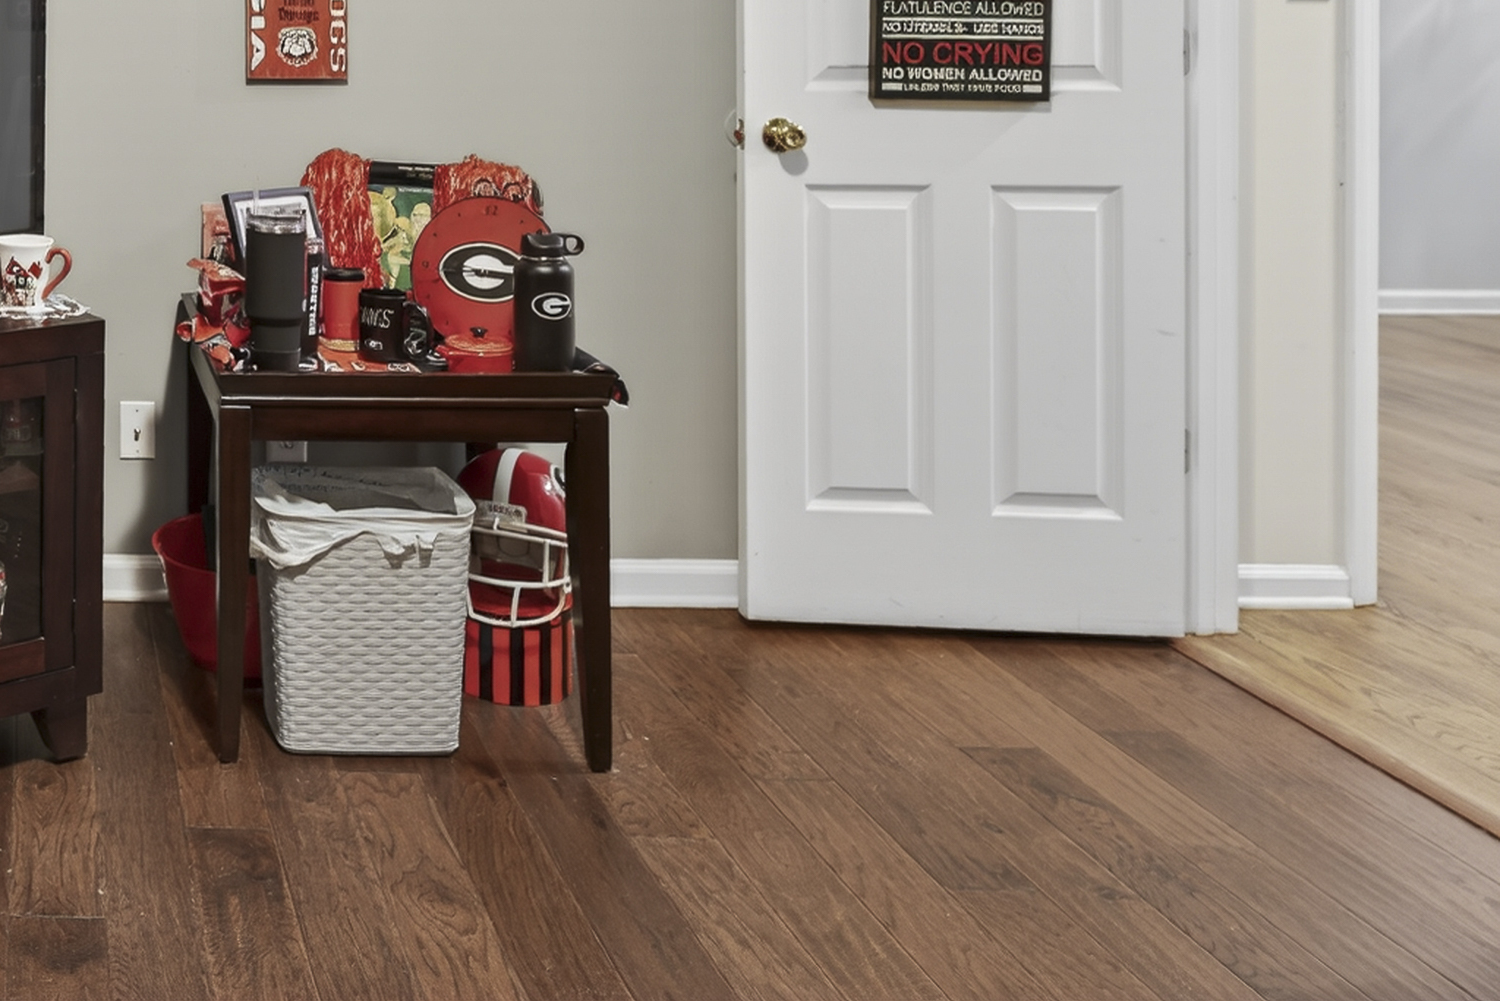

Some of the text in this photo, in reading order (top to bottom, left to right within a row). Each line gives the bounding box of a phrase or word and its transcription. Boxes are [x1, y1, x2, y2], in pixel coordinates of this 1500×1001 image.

[883, 0, 1045, 16] FLATULENCE ALLOWED
[882, 21, 901, 33] NO
[882, 41, 1044, 65] NO CRYING
[882, 67, 1043, 82] NO WOMEN ALLOWED
